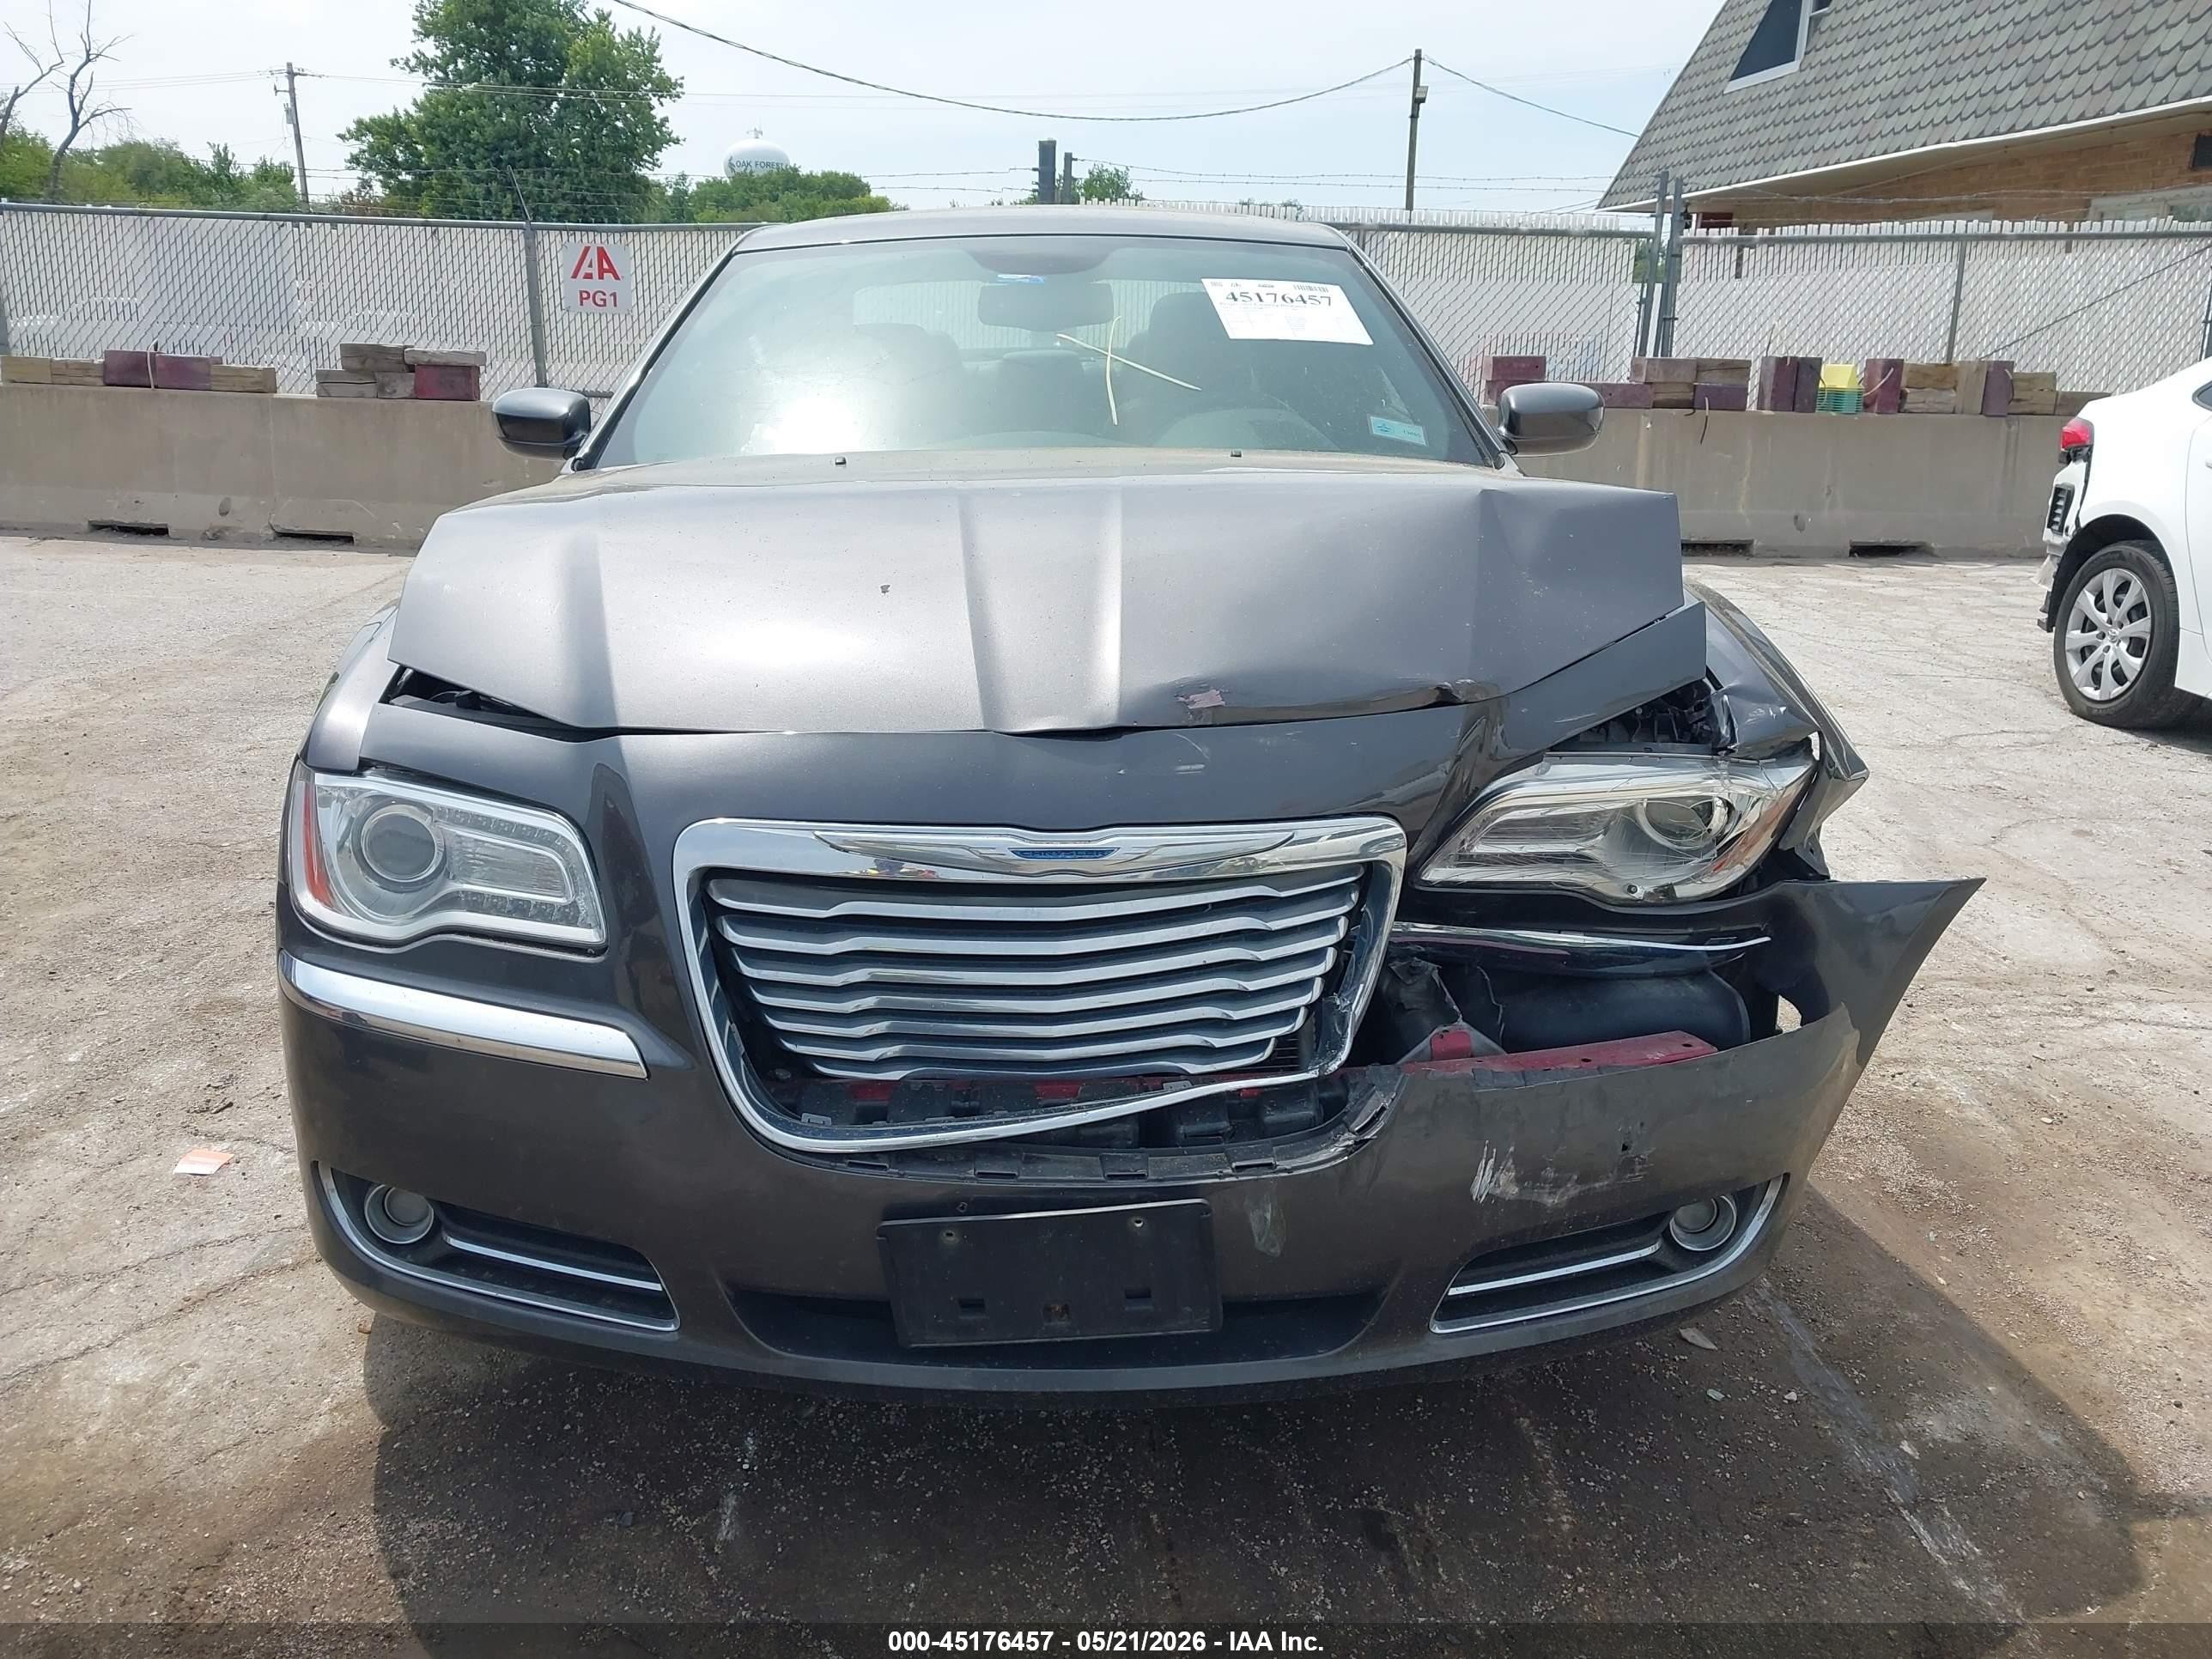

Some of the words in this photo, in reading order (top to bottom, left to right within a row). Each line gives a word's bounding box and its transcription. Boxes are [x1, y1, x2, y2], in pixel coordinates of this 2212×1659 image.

[735, 160, 752, 168] OAK
[755, 161, 783, 170] FOREST
[578, 289, 617, 307] PG1
[1225, 291, 1331, 307] 45176457
